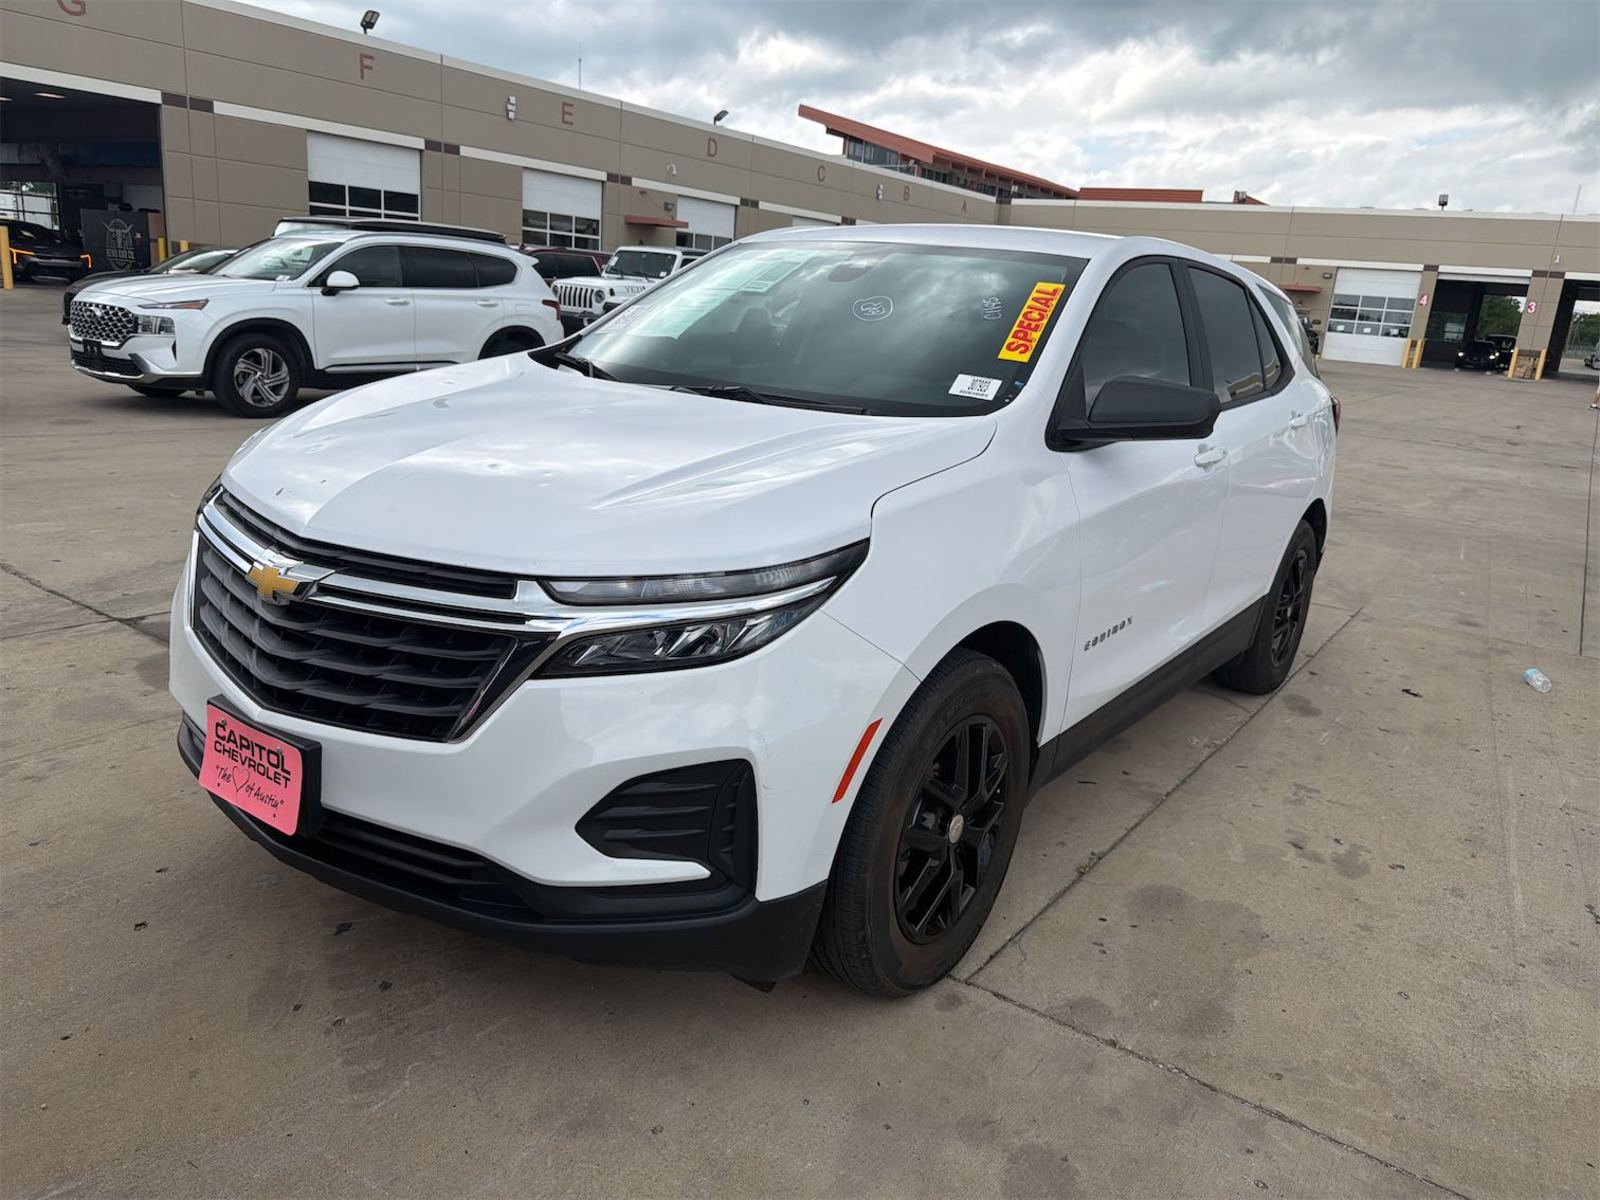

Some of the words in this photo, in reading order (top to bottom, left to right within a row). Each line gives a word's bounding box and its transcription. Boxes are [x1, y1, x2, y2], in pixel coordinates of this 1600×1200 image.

[359, 53, 375, 80] F
[561, 102, 573, 125] E
[707, 137, 718, 158] D
[817, 165, 826, 182] C
[903, 185, 910, 201] B
[961, 200, 967, 216] A
[1419, 294, 1429, 306] 4
[1527, 301, 1537, 313] 3
[1005, 287, 1062, 355] SPECIAL
[1084, 615, 1133, 651] EQUINOX
[215, 722, 291, 776] CAPITOL
[214, 740, 291, 789] CHEVROLET
[245, 782, 255, 797] of
